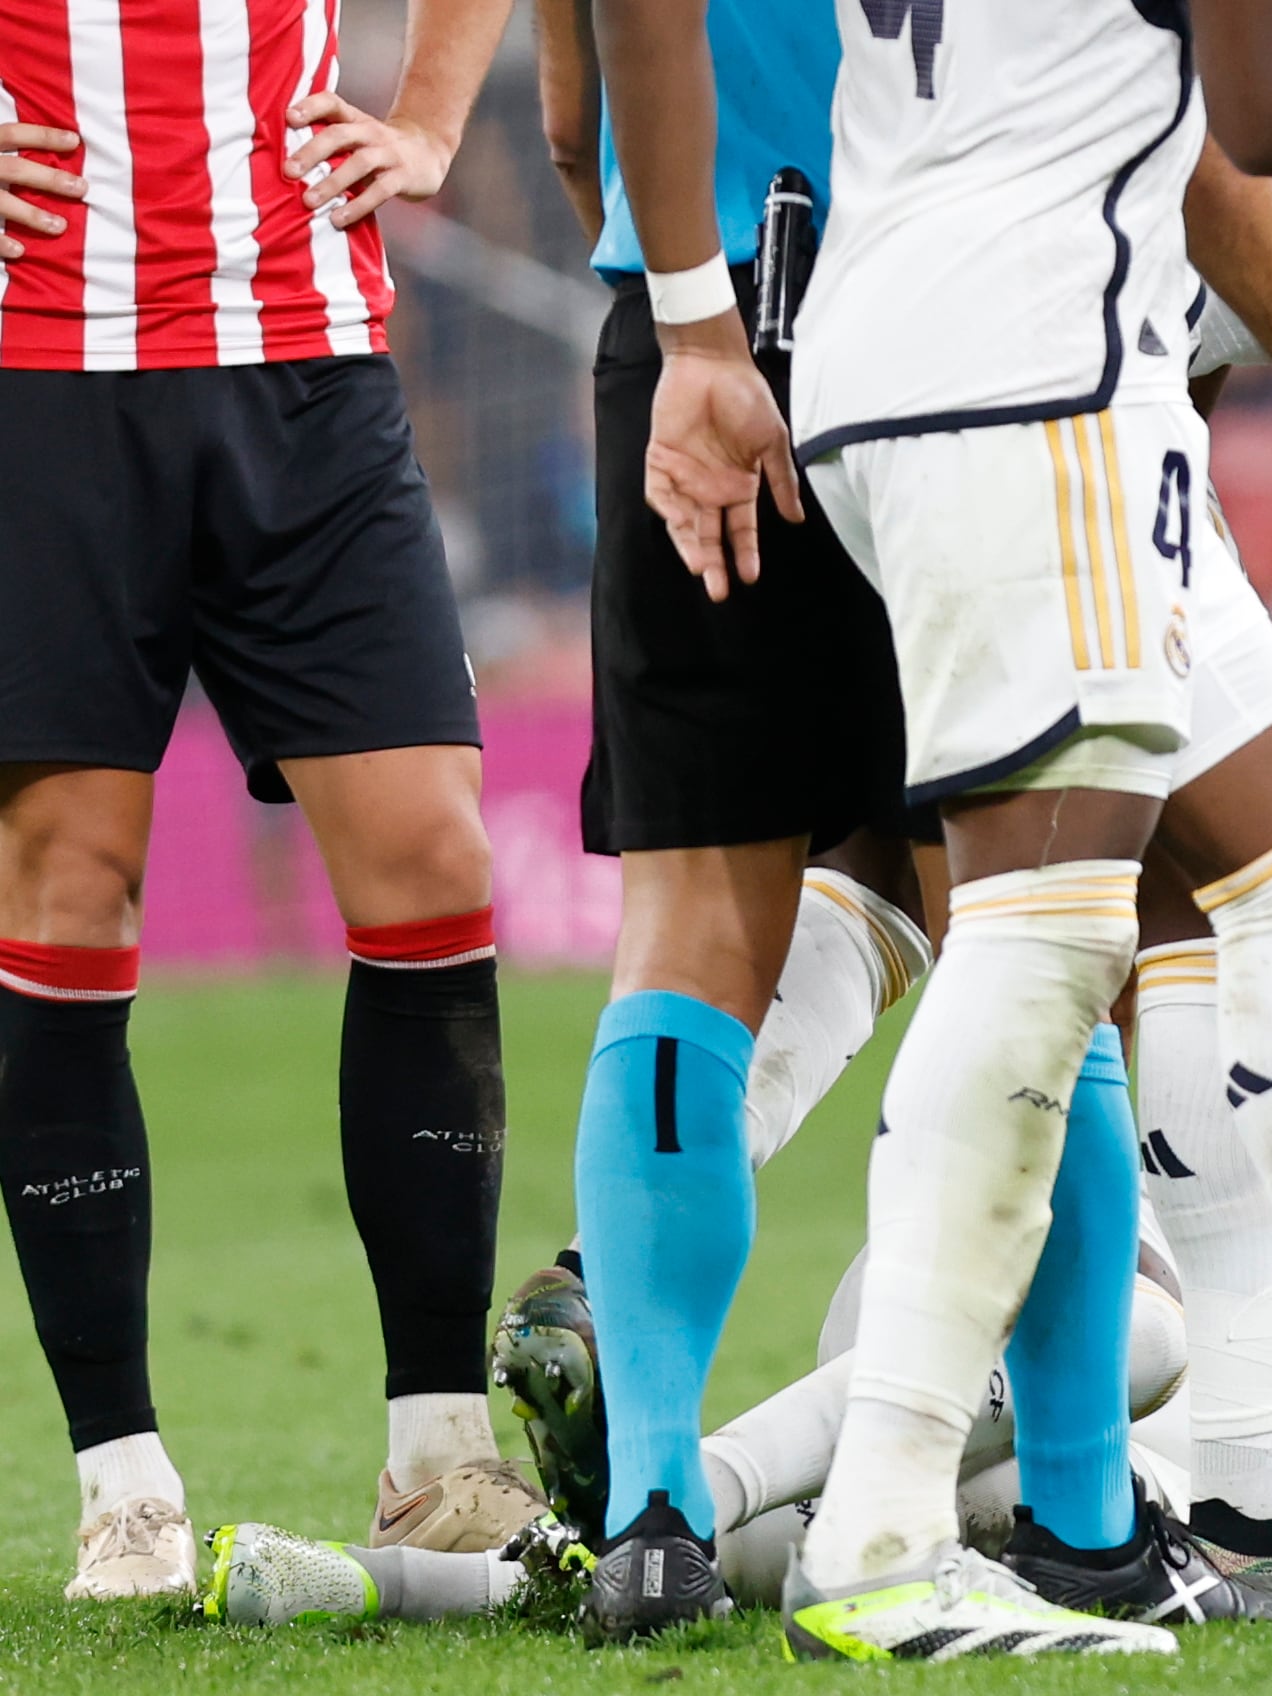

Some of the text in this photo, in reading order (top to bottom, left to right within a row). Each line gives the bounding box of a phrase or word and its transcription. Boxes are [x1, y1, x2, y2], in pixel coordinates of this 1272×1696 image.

[1152, 450, 1191, 589] 4
[21, 1167, 141, 1196] ATHLETIC
[50, 1179, 124, 1205] CLUB
